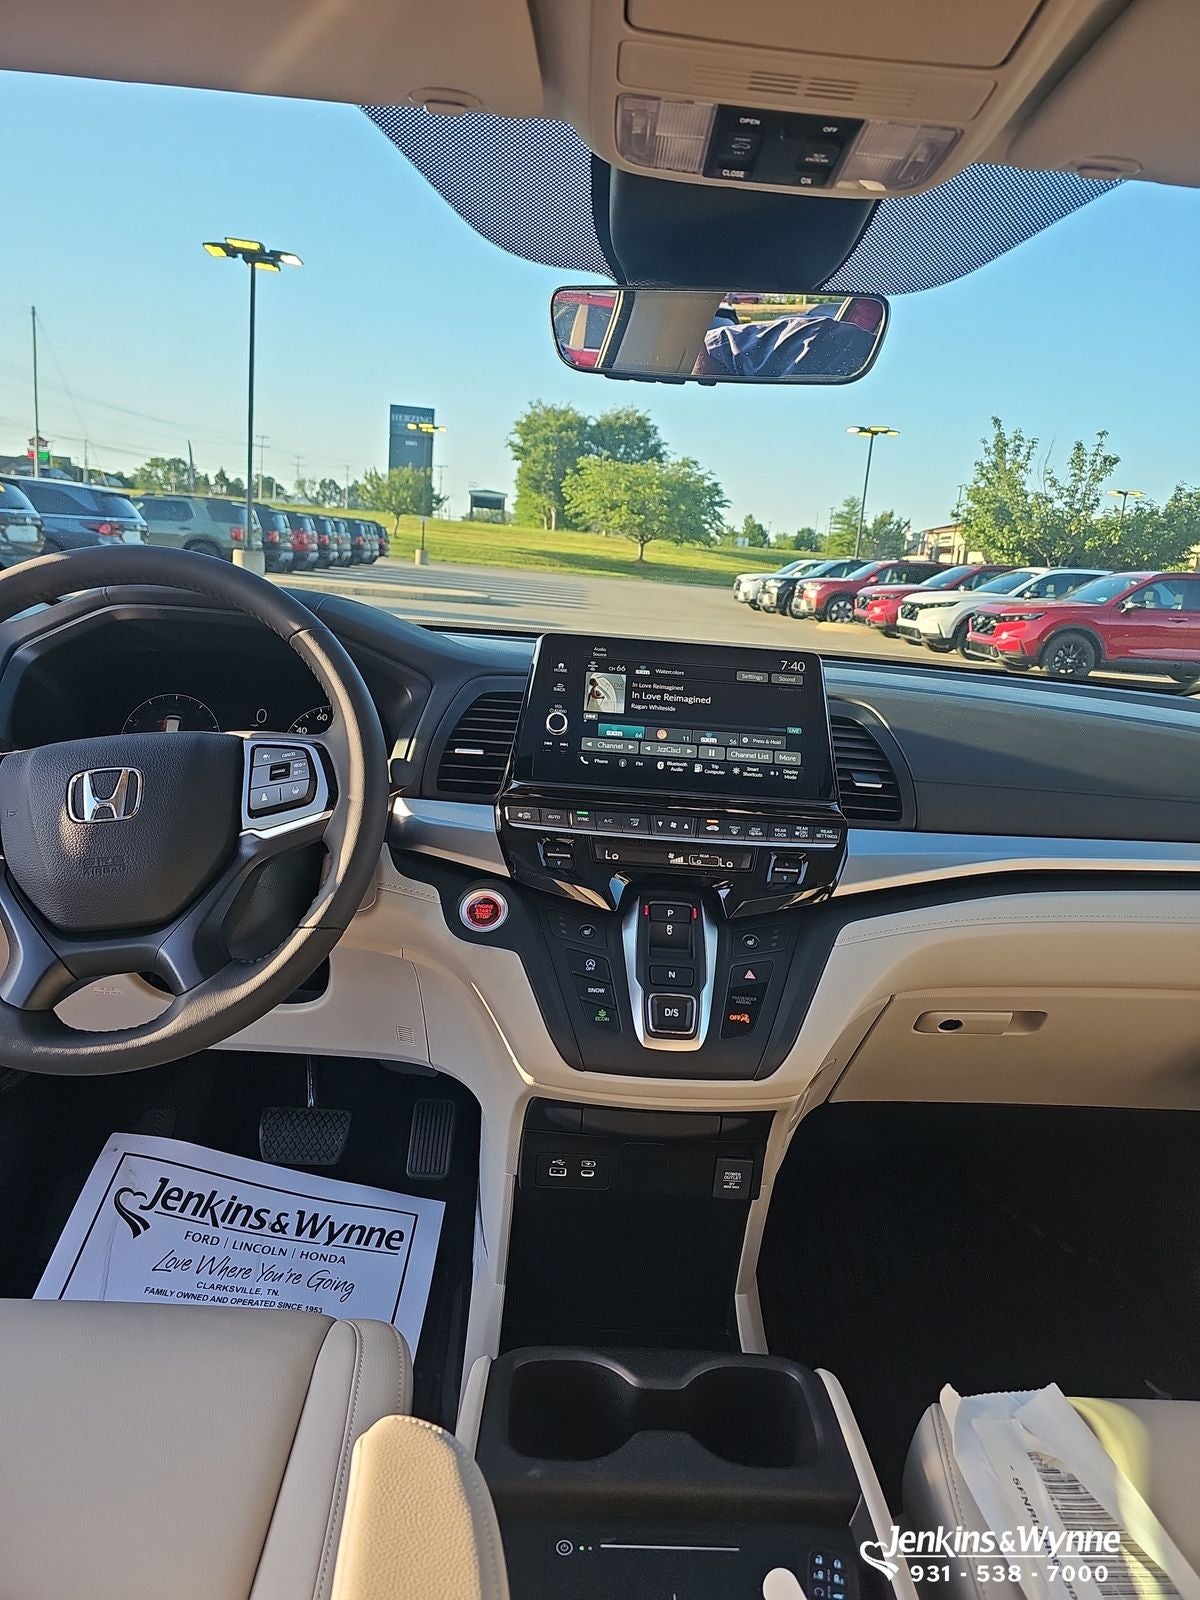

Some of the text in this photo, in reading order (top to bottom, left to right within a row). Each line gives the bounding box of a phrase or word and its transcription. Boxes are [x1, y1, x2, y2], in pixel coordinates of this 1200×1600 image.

[740, 118, 760, 126] OPEN
[722, 170, 745, 178] CLOSE
[780, 660, 806, 672] 7:40
[642, 692, 661, 700] Love
[664, 693, 711, 705] Reimagined
[256, 708, 267, 724] 0
[316, 712, 328, 722] 60
[296, 726, 308, 735] 40
[598, 742, 624, 750] Channel
[730, 751, 756, 759] Channel
[605, 850, 619, 860] Lo
[720, 858, 734, 868] Lo
[668, 910, 674, 918] P
[664, 1008, 679, 1017] D/S
[139, 1177, 270, 1229] Jenkins
[294, 1210, 404, 1250] Wynne
[184, 1230, 346, 1265] FORD LINCOLN HONDA
[152, 1249, 356, 1302] Love Where You're Going
[196, 1281, 280, 1298] CLARKSVILLE, TN.
[144, 1286, 323, 1314] FAMILY OWNED AND OPERATED SINCE 1953
